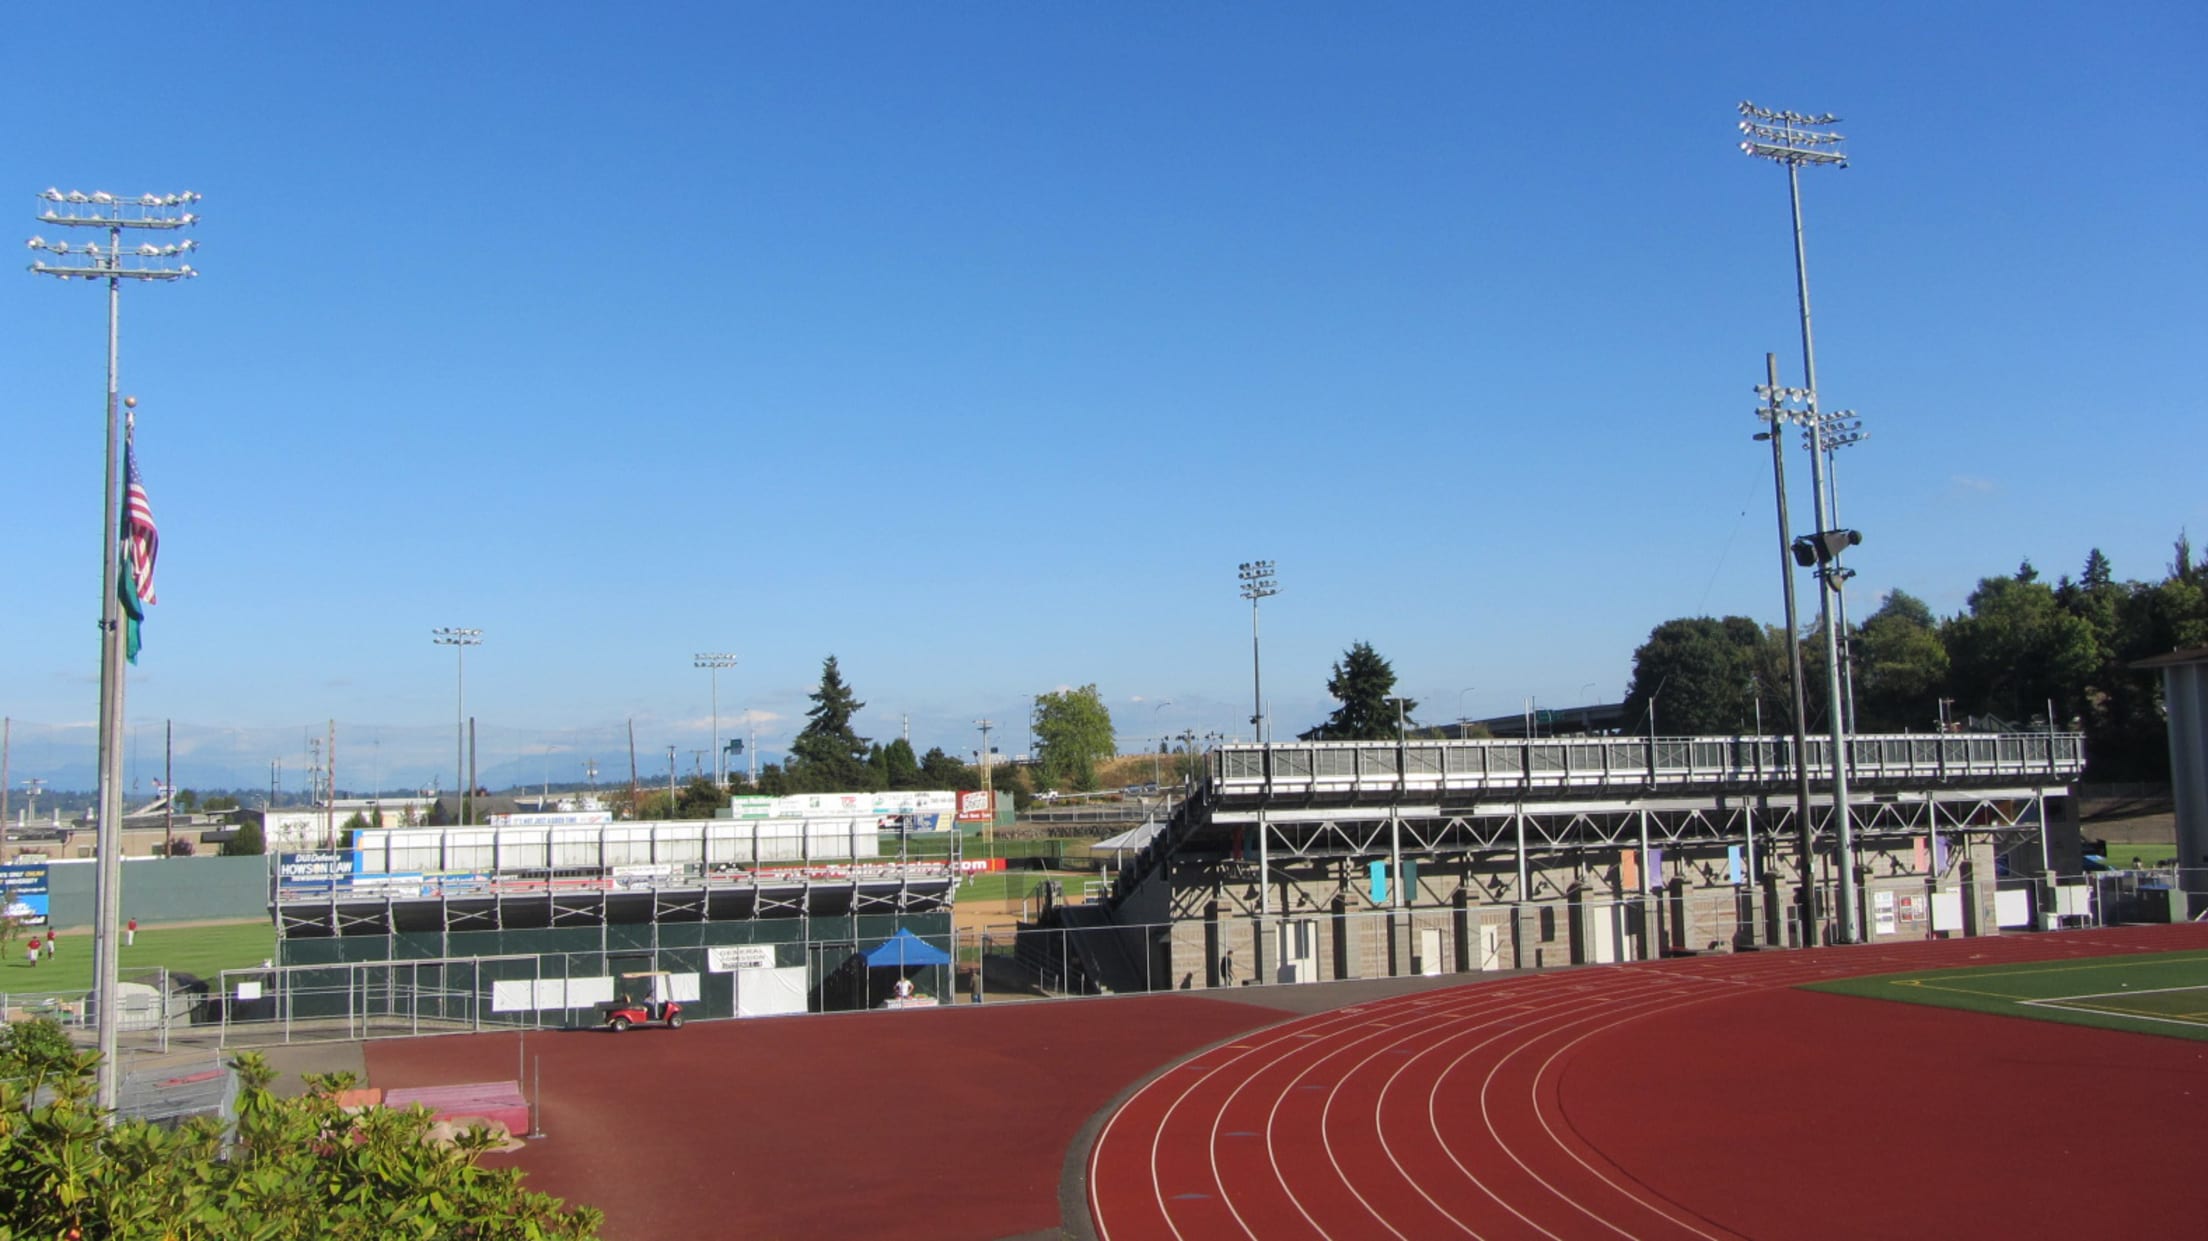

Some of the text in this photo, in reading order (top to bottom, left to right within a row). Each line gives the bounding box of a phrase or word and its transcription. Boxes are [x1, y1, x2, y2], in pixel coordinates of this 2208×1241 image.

[295, 854, 311, 863] DUI
[281, 862, 353, 875] HOWSON LAW
[720, 948, 763, 956] GENERAL
